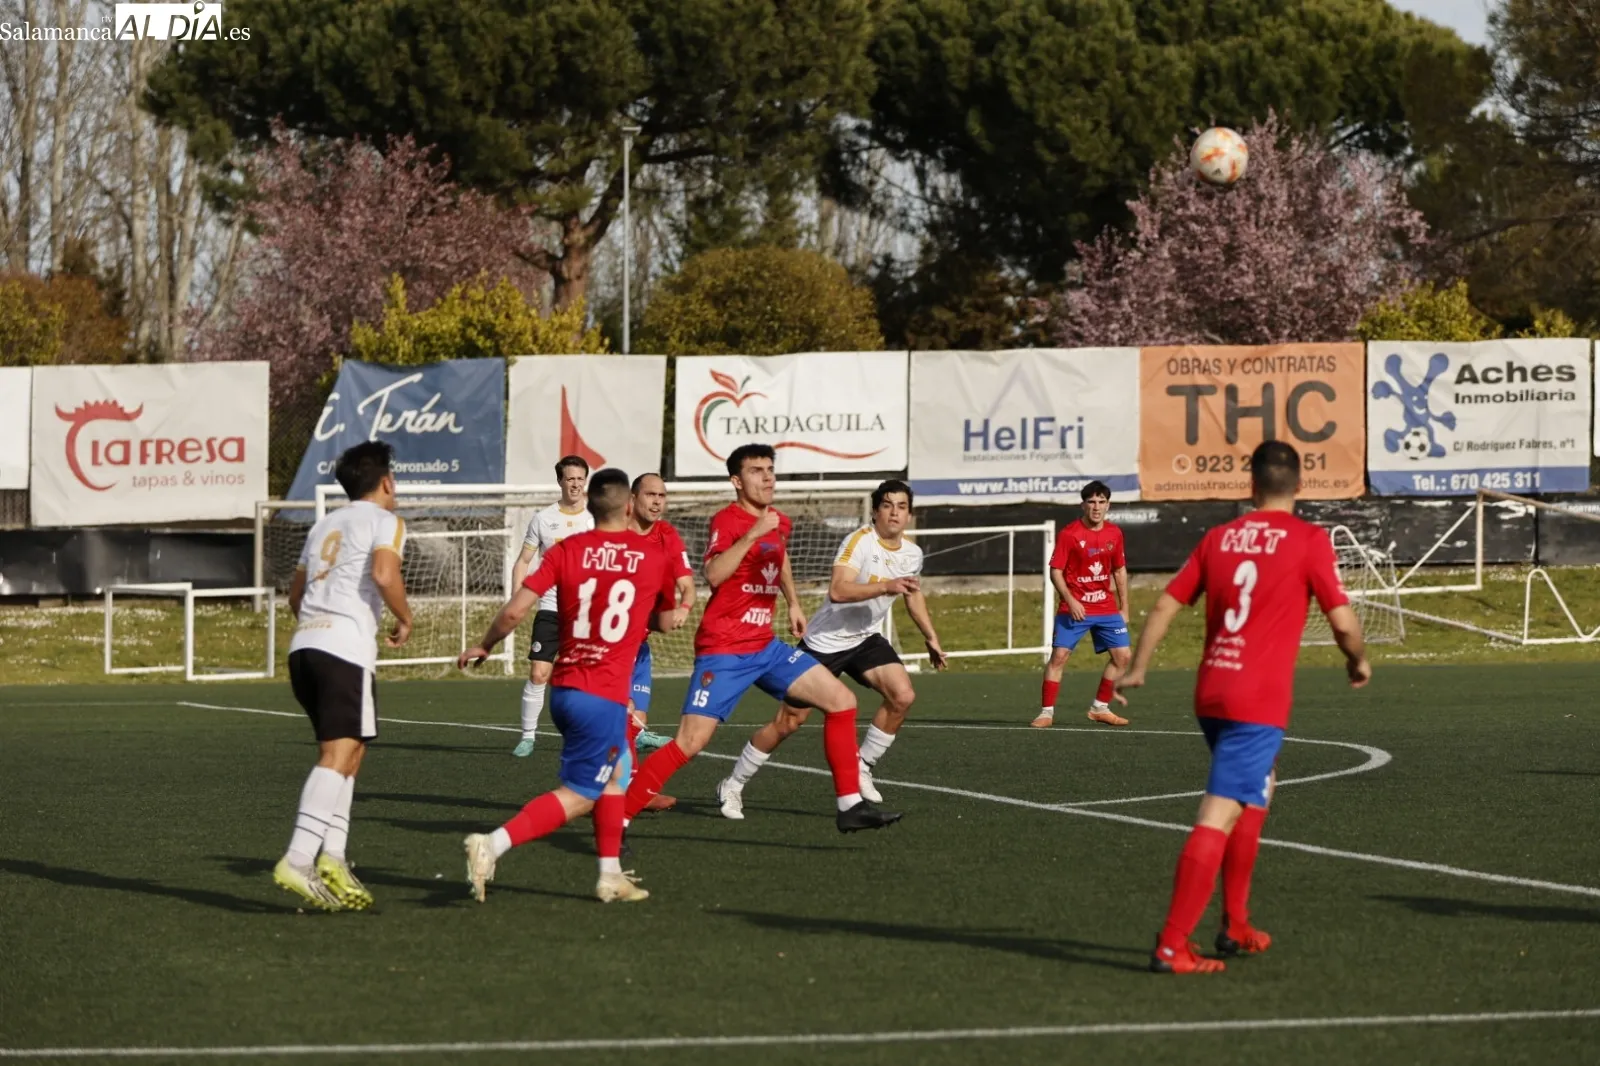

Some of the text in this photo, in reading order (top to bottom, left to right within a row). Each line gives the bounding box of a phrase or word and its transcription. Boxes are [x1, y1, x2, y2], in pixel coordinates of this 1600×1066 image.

[1167, 355, 1337, 375] OBRAS Y CONTRATAS
[1454, 361, 1577, 385] Aches
[357, 372, 464, 443] Terán
[1454, 389, 1576, 404] Inmobiliaria
[719, 412, 886, 435] TARDAGUILA
[1166, 379, 1337, 446] THC
[963, 416, 1084, 452] HelFri
[451, 459, 461, 472] 5
[1195, 455, 1234, 472] 923
[131, 470, 246, 490] tapas & vinos
[1412, 471, 1541, 491] Tel.: 670 425 311
[582, 547, 644, 574] HLT
[1225, 560, 1257, 632] 3
[573, 577, 636, 643] 18
[692, 688, 710, 707] 15
